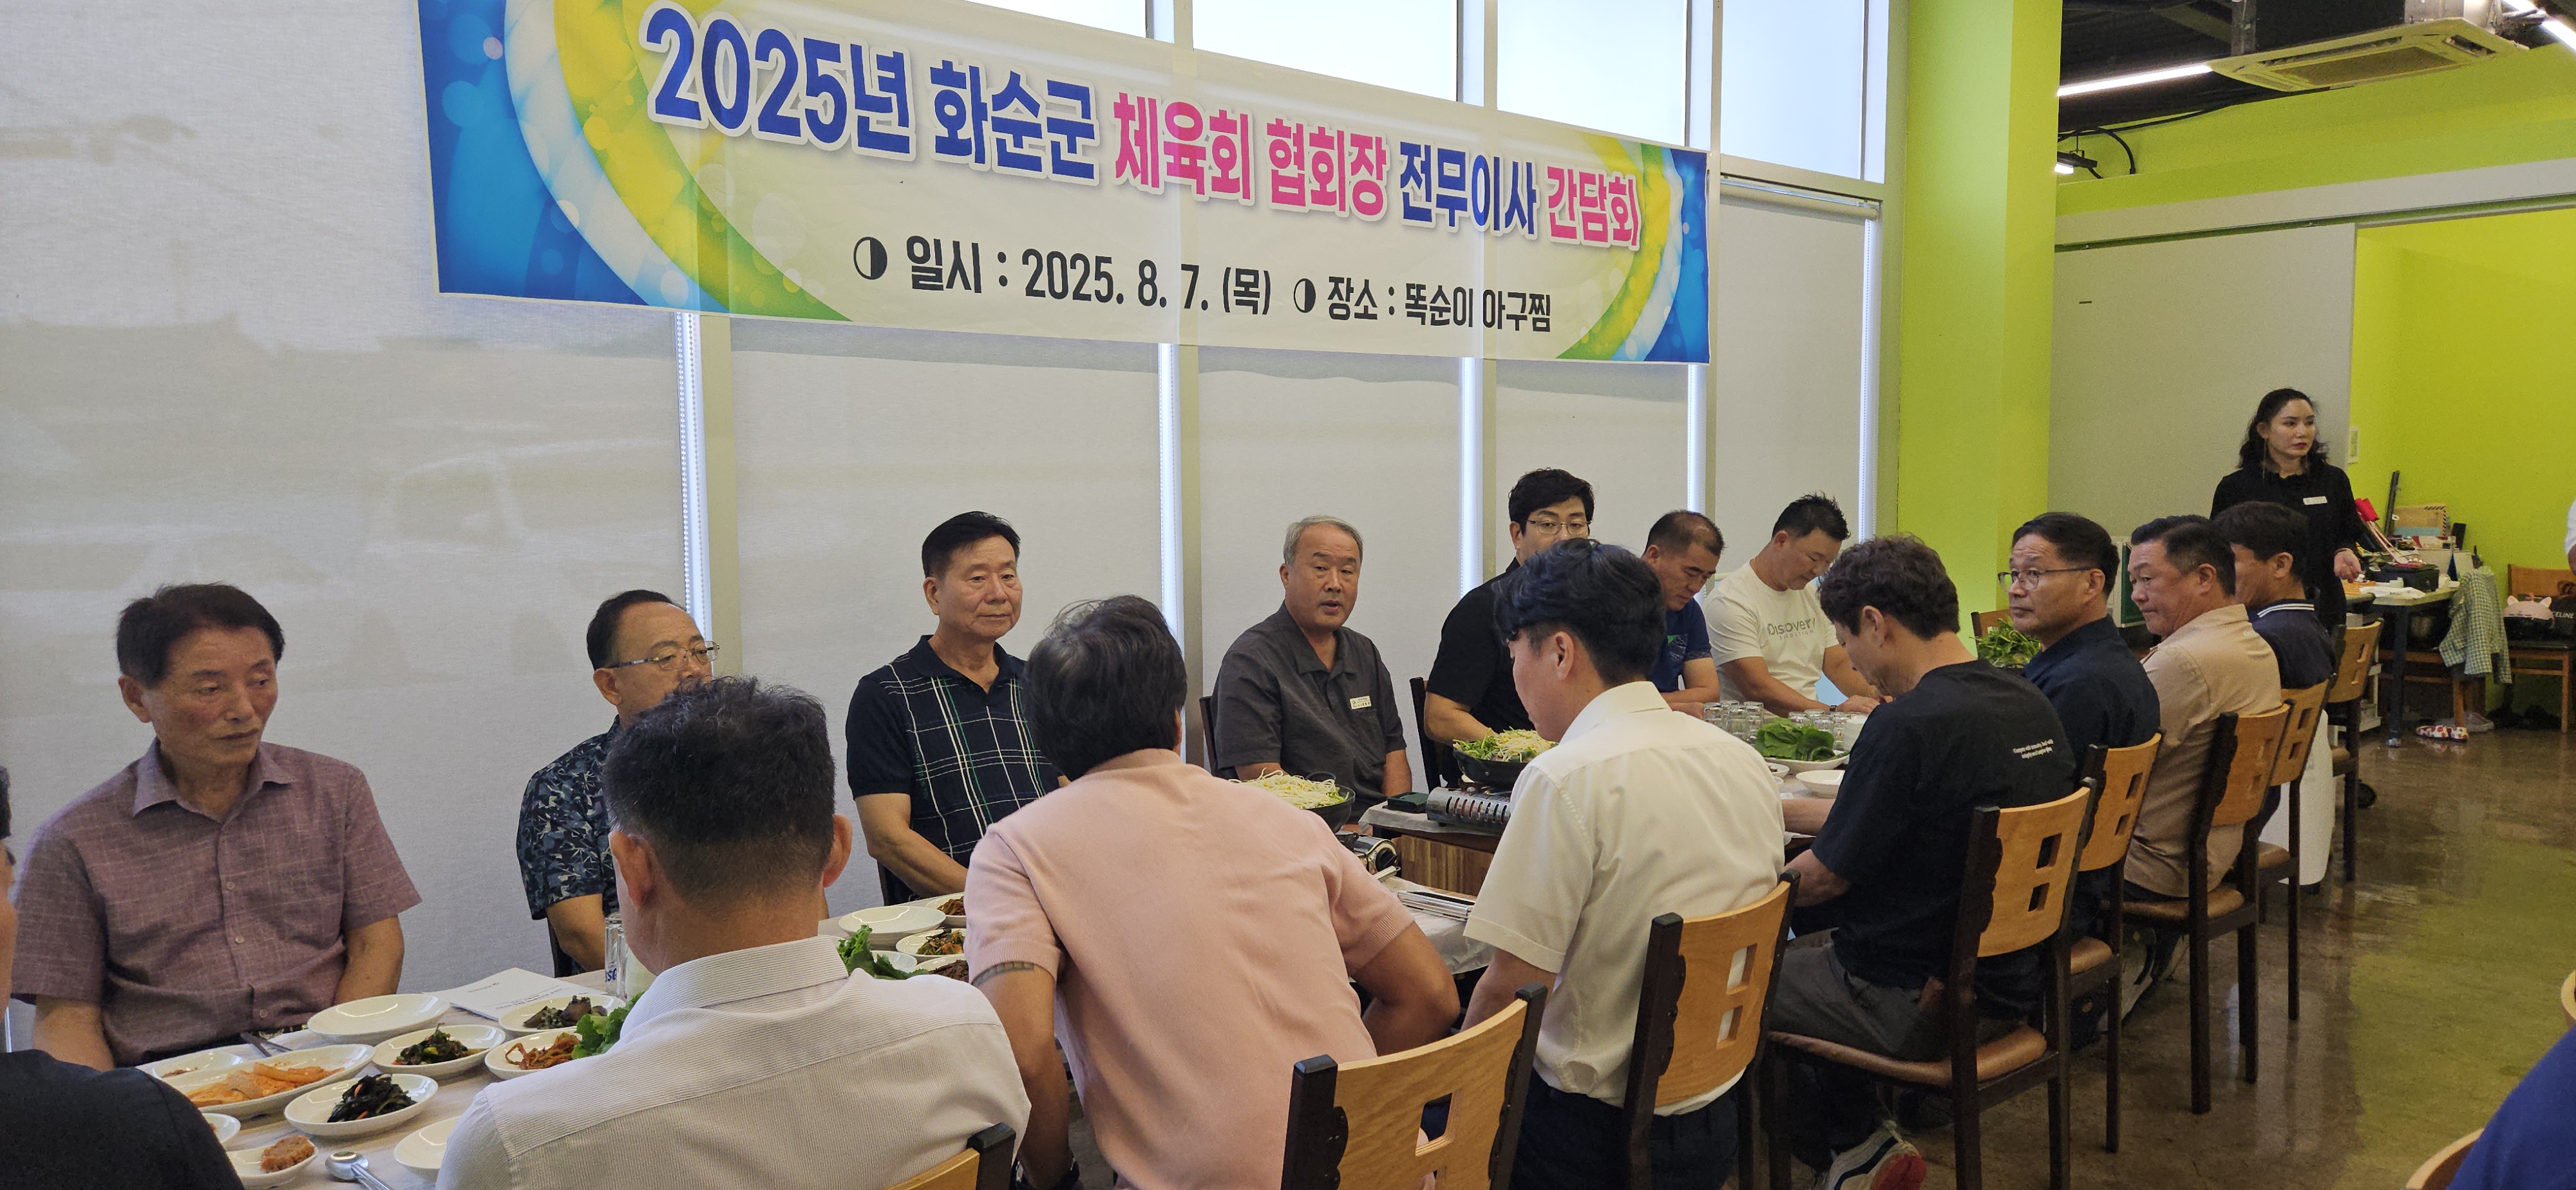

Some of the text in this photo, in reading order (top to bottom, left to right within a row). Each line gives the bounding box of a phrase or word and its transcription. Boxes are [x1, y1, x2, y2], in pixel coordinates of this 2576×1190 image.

[647, 8, 1638, 246] 2025년 화순군 체육회 협회장 전무이사 간담회
[906, 236, 981, 293] 일시
[1022, 248, 1124, 305] 2025.
[1138, 260, 1166, 308] 8.
[1181, 264, 1208, 311] 7.
[1223, 267, 1271, 315] (목)
[1327, 276, 1378, 320] 장소
[1405, 283, 1473, 328] 똑순이
[1483, 289, 1550, 332] 아구찜
[1767, 618, 1815, 636] Disovery
